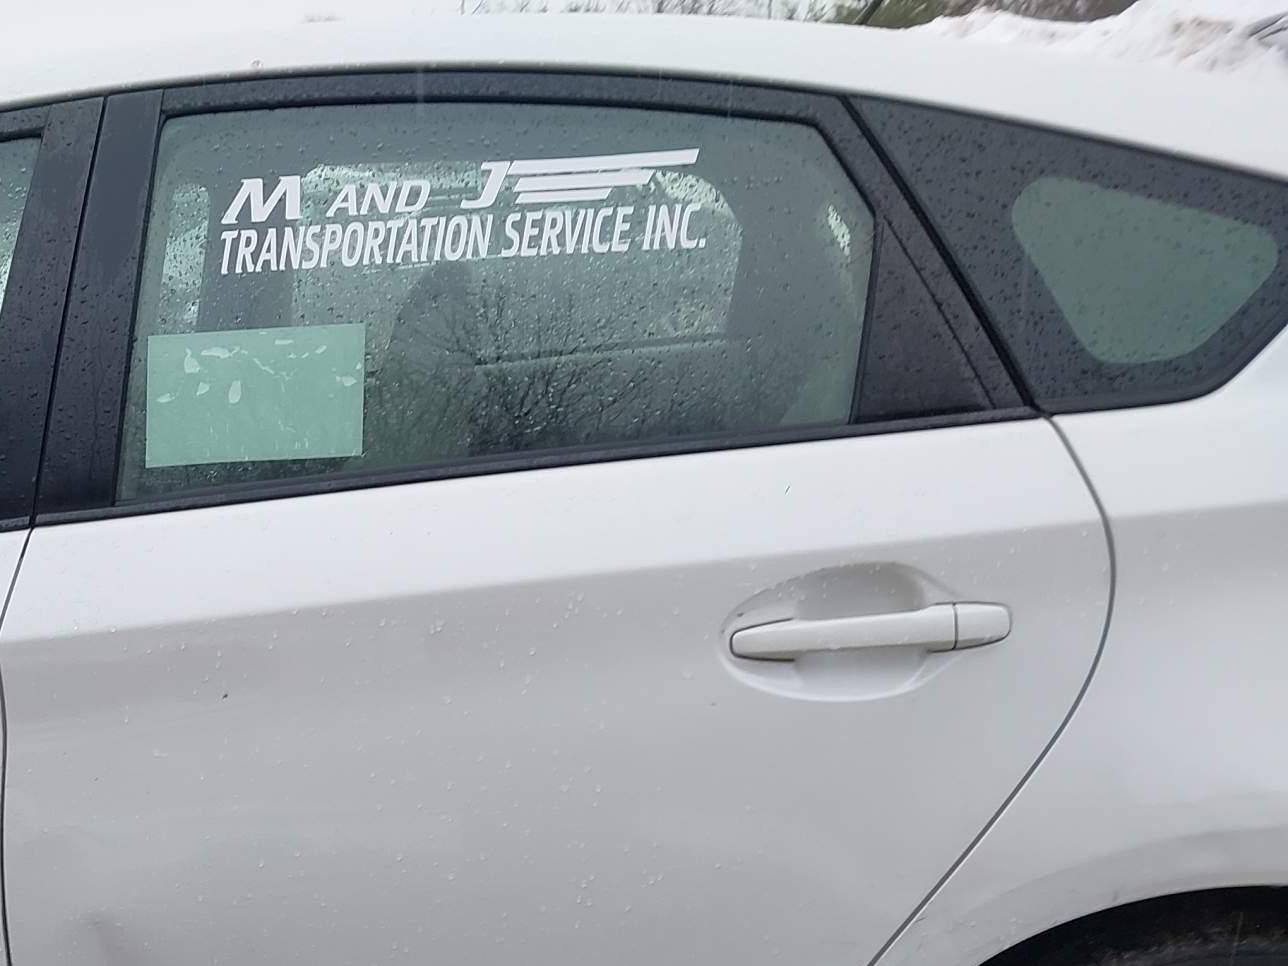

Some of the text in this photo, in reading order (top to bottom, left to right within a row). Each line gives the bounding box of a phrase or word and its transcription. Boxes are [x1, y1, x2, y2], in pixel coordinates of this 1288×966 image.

[220, 160, 512, 225] M AND J
[220, 202, 707, 275] TRANSPORTATION SERVICE INC.
